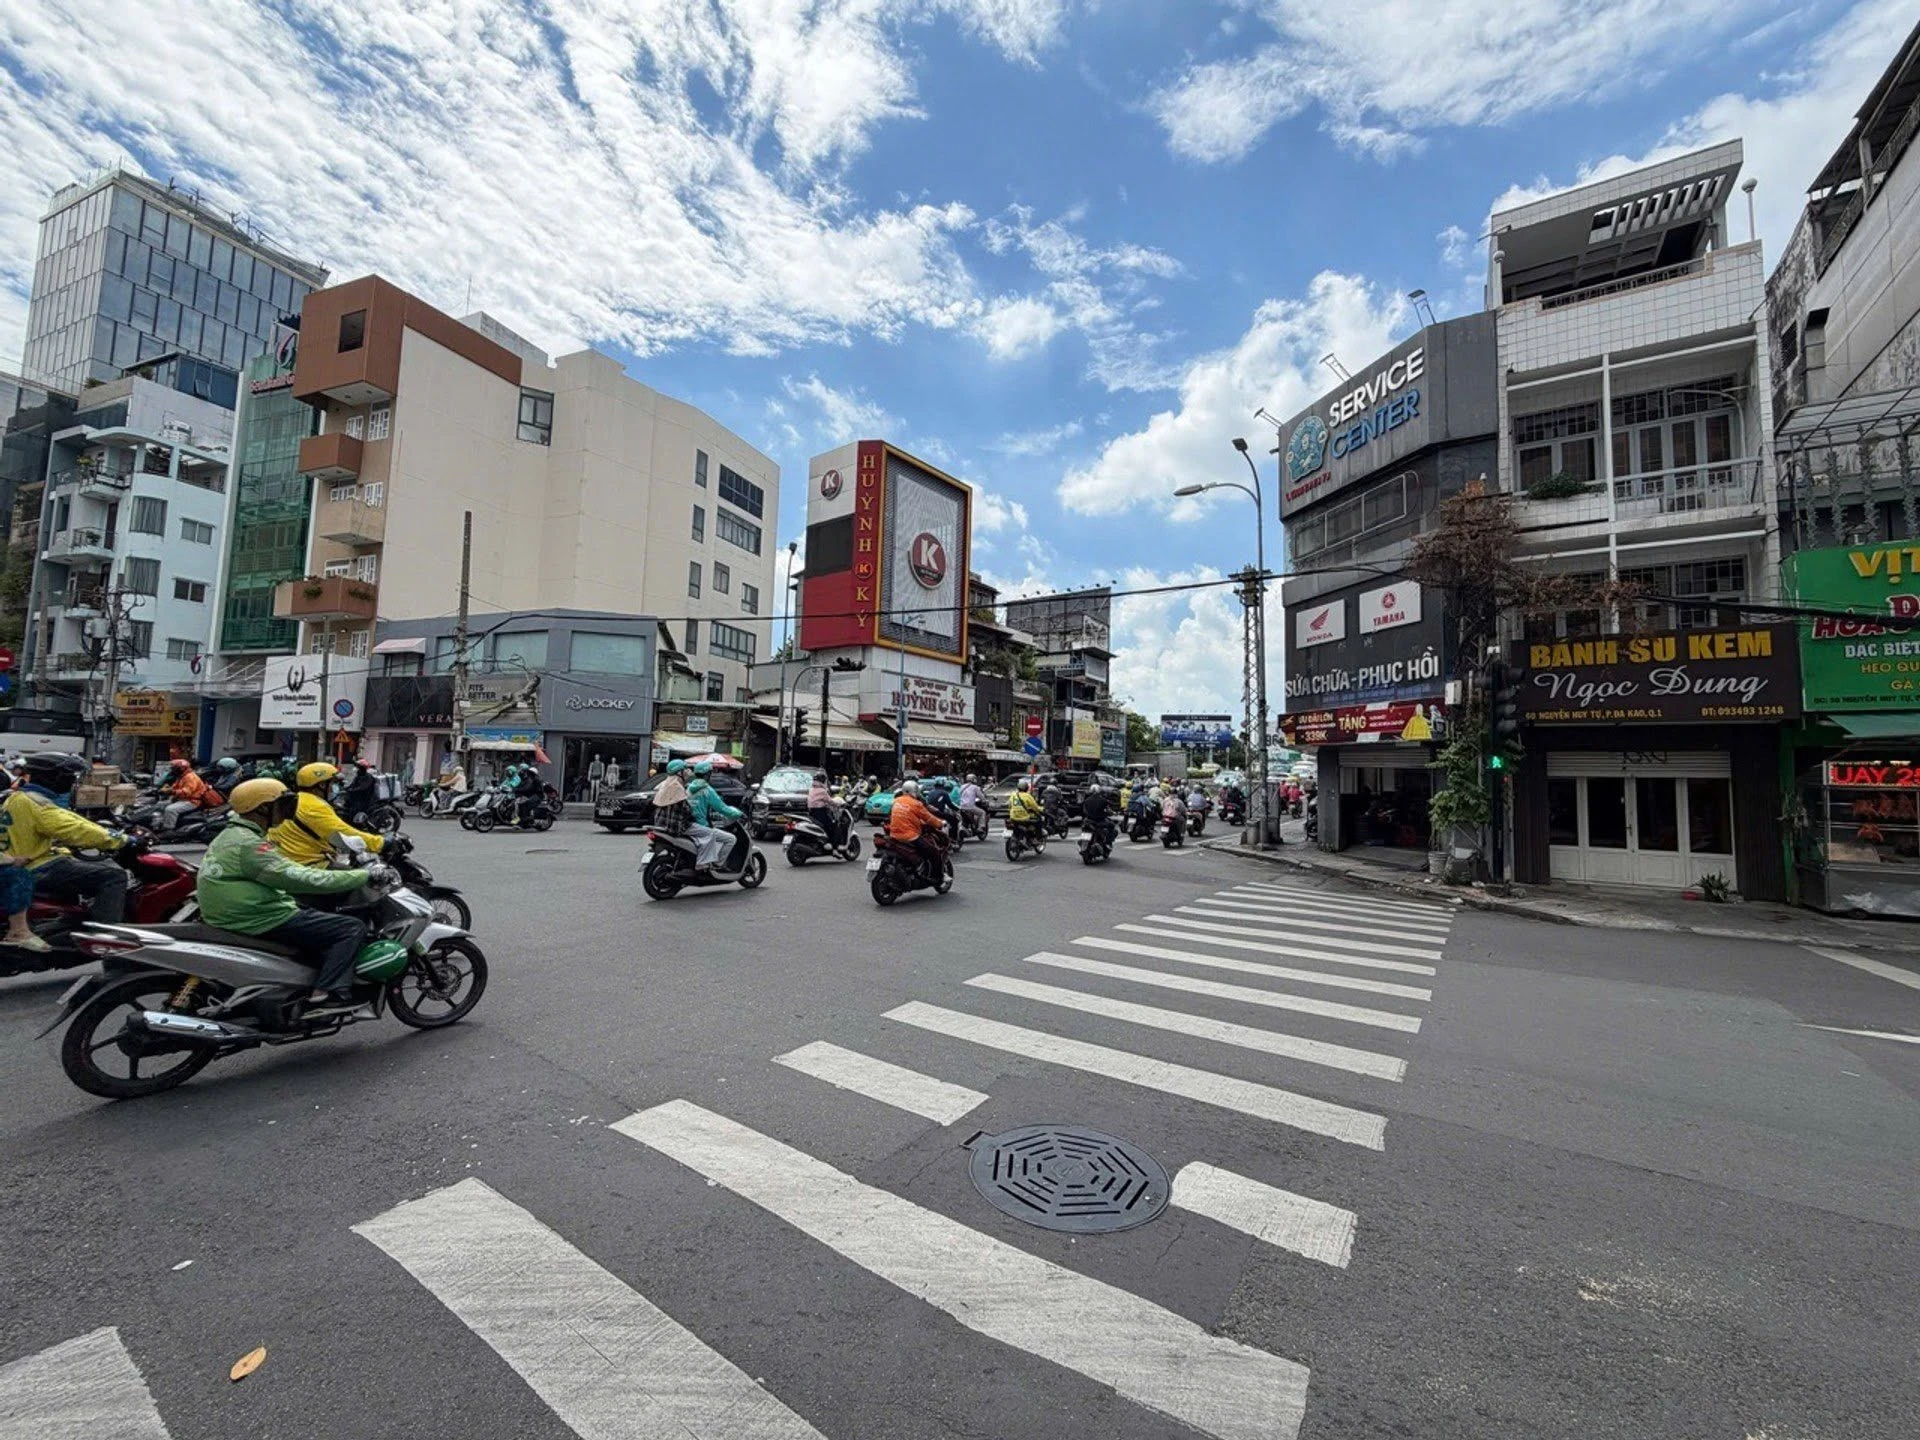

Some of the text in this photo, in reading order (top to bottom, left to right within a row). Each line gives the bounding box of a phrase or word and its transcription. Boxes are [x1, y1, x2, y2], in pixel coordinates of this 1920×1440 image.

[1329, 347, 1424, 428] SERVICE
[1331, 388, 1420, 460] CENTER
[859, 454, 876, 552] HUỲNH
[920, 539, 939, 570] K
[1848, 548, 1920, 584] VỊT
[1373, 610, 1405, 627] YAMAHA
[1530, 630, 1772, 668] BÁNH SU KEM
[1285, 672, 1312, 698] SỬA
[1312, 668, 1350, 694] CHỮA
[1358, 661, 1403, 689] PHỤC
[1407, 646, 1439, 681] HỒI
[1533, 665, 1769, 707] Ngọc Dung
[1861, 663, 1891, 673] HEO
[419, 714, 452, 723] VERA
[582, 697, 635, 710] JOCKEY
